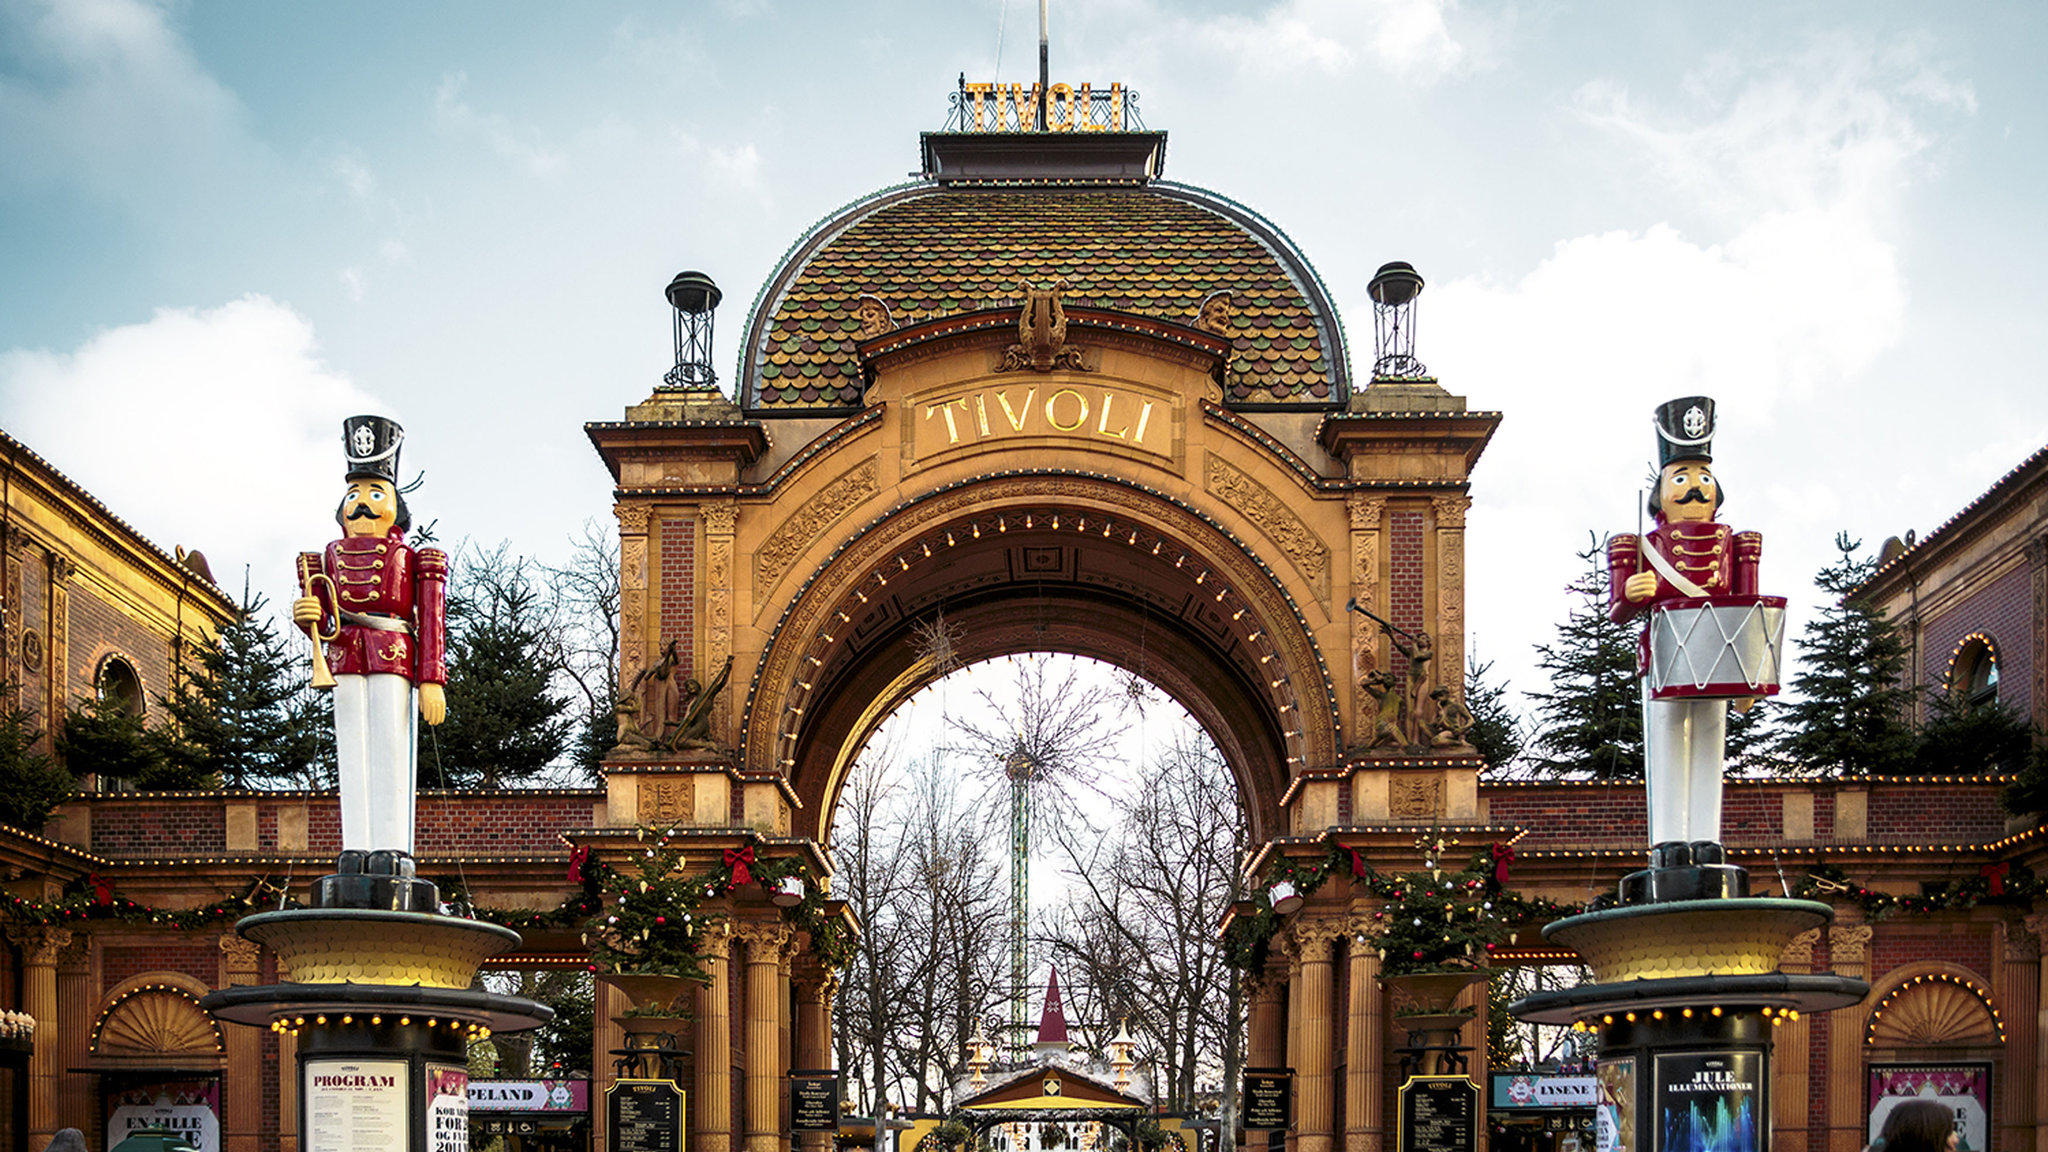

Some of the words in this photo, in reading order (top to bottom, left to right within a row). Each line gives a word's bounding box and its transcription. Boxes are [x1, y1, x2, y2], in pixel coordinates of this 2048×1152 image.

[966, 82, 1121, 132] TIVOLI
[926, 387, 1153, 444] TIVOLI
[314, 1074, 395, 1087] PROGRAM
[1691, 1070, 1735, 1083] JULE
[632, 1085, 657, 1093] TIVOLI
[1540, 1086, 1590, 1096] LYSENE
[1668, 1082, 1753, 1092] ILLUMINATIONER
[468, 1089, 534, 1101] PELAND
[126, 1117, 149, 1129] EN
[436, 1117, 462, 1130] FOR
